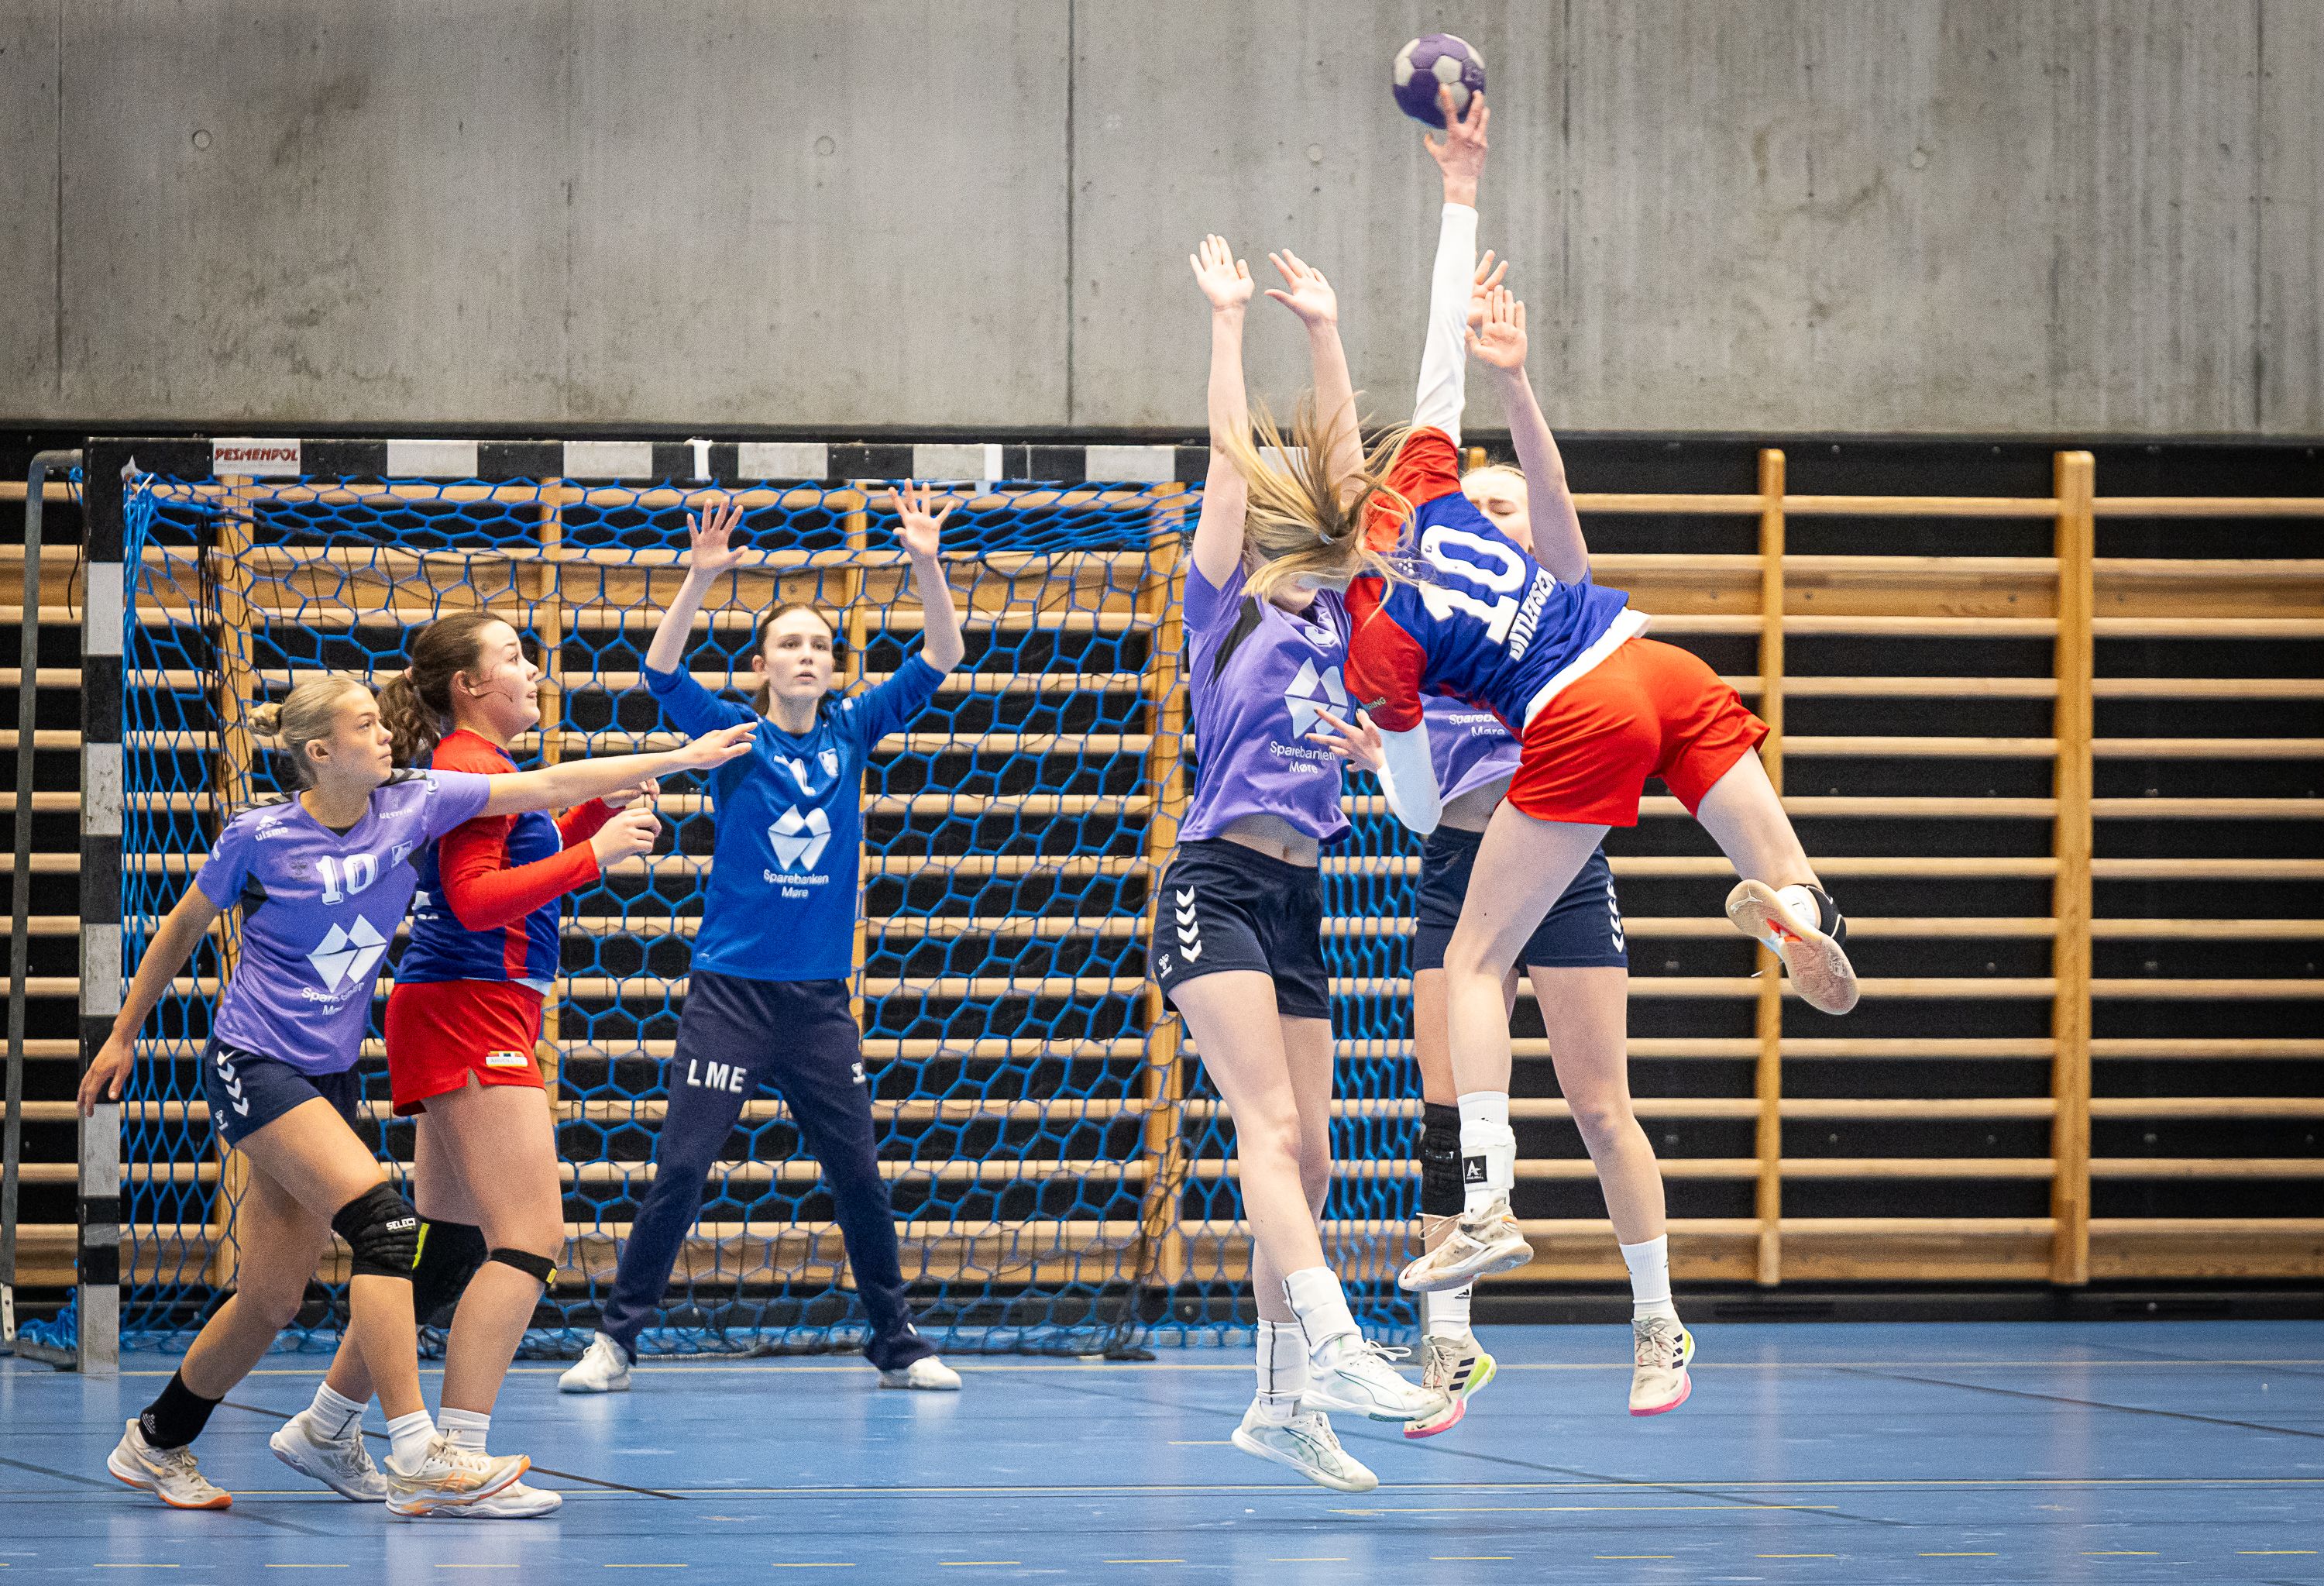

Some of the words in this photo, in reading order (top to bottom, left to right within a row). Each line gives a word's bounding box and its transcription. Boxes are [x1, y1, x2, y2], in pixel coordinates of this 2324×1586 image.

[215, 448, 298, 461] PESMENPOL
[1270, 741, 1336, 761] Sparebanken
[1288, 760, 1318, 773] Møre
[315, 852, 379, 905] 10
[763, 869, 830, 885] Sparebanken
[686, 1058, 748, 1093] LME
